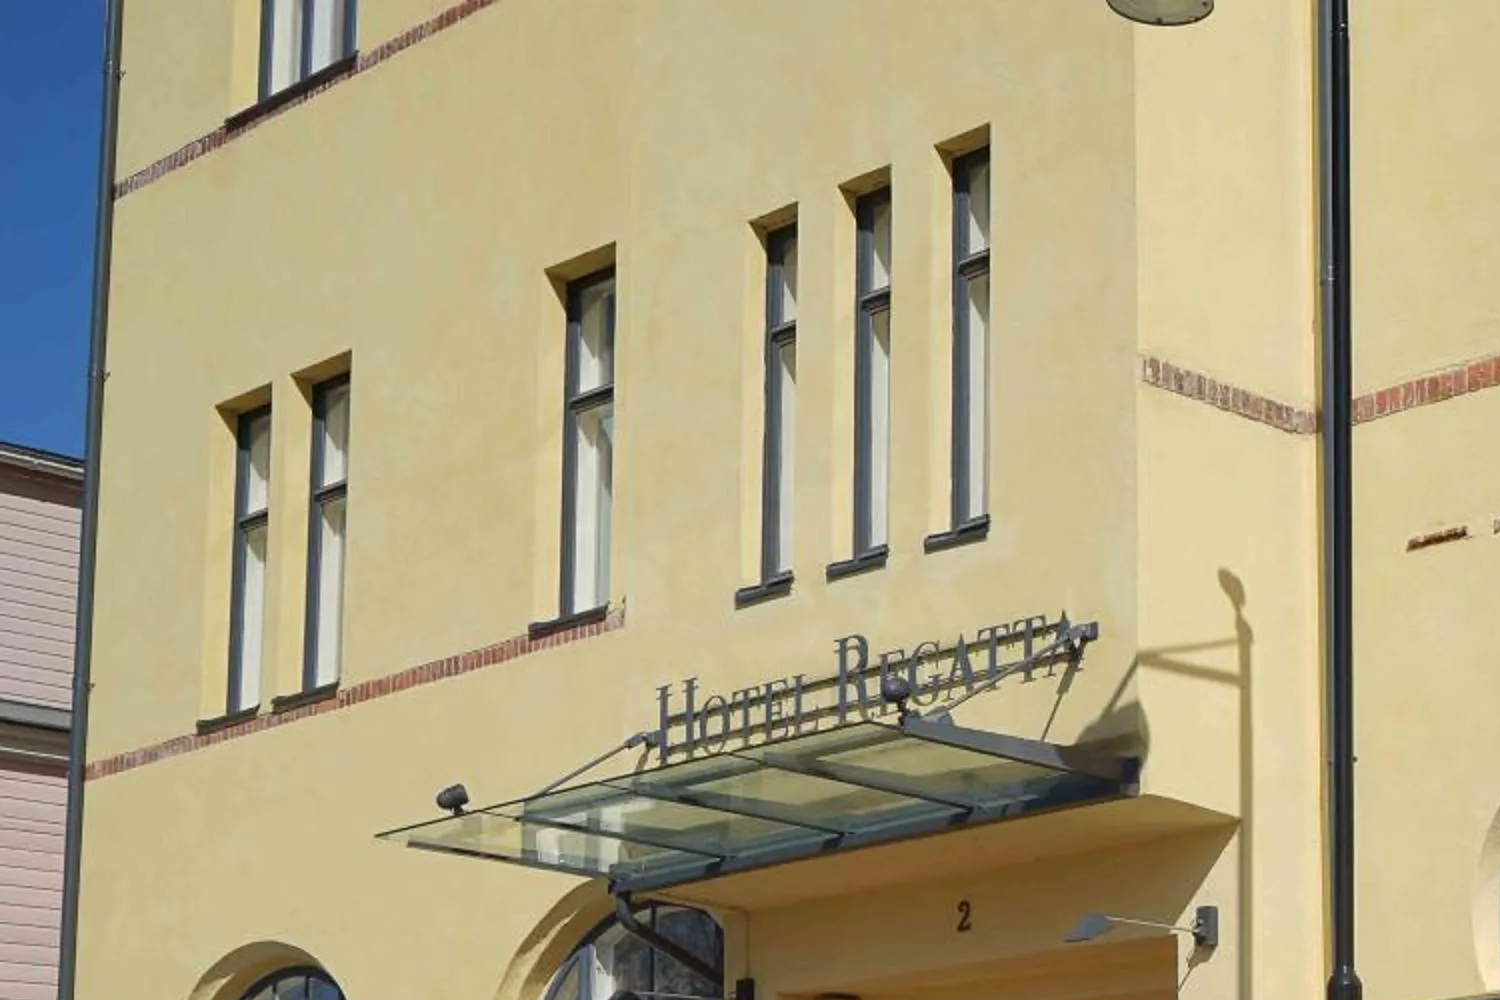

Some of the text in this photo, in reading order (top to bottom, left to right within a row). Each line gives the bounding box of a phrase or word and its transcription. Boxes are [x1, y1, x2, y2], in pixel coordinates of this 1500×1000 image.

[656, 609, 1084, 767] HOTEL REGATTA
[956, 900, 972, 932] 2
